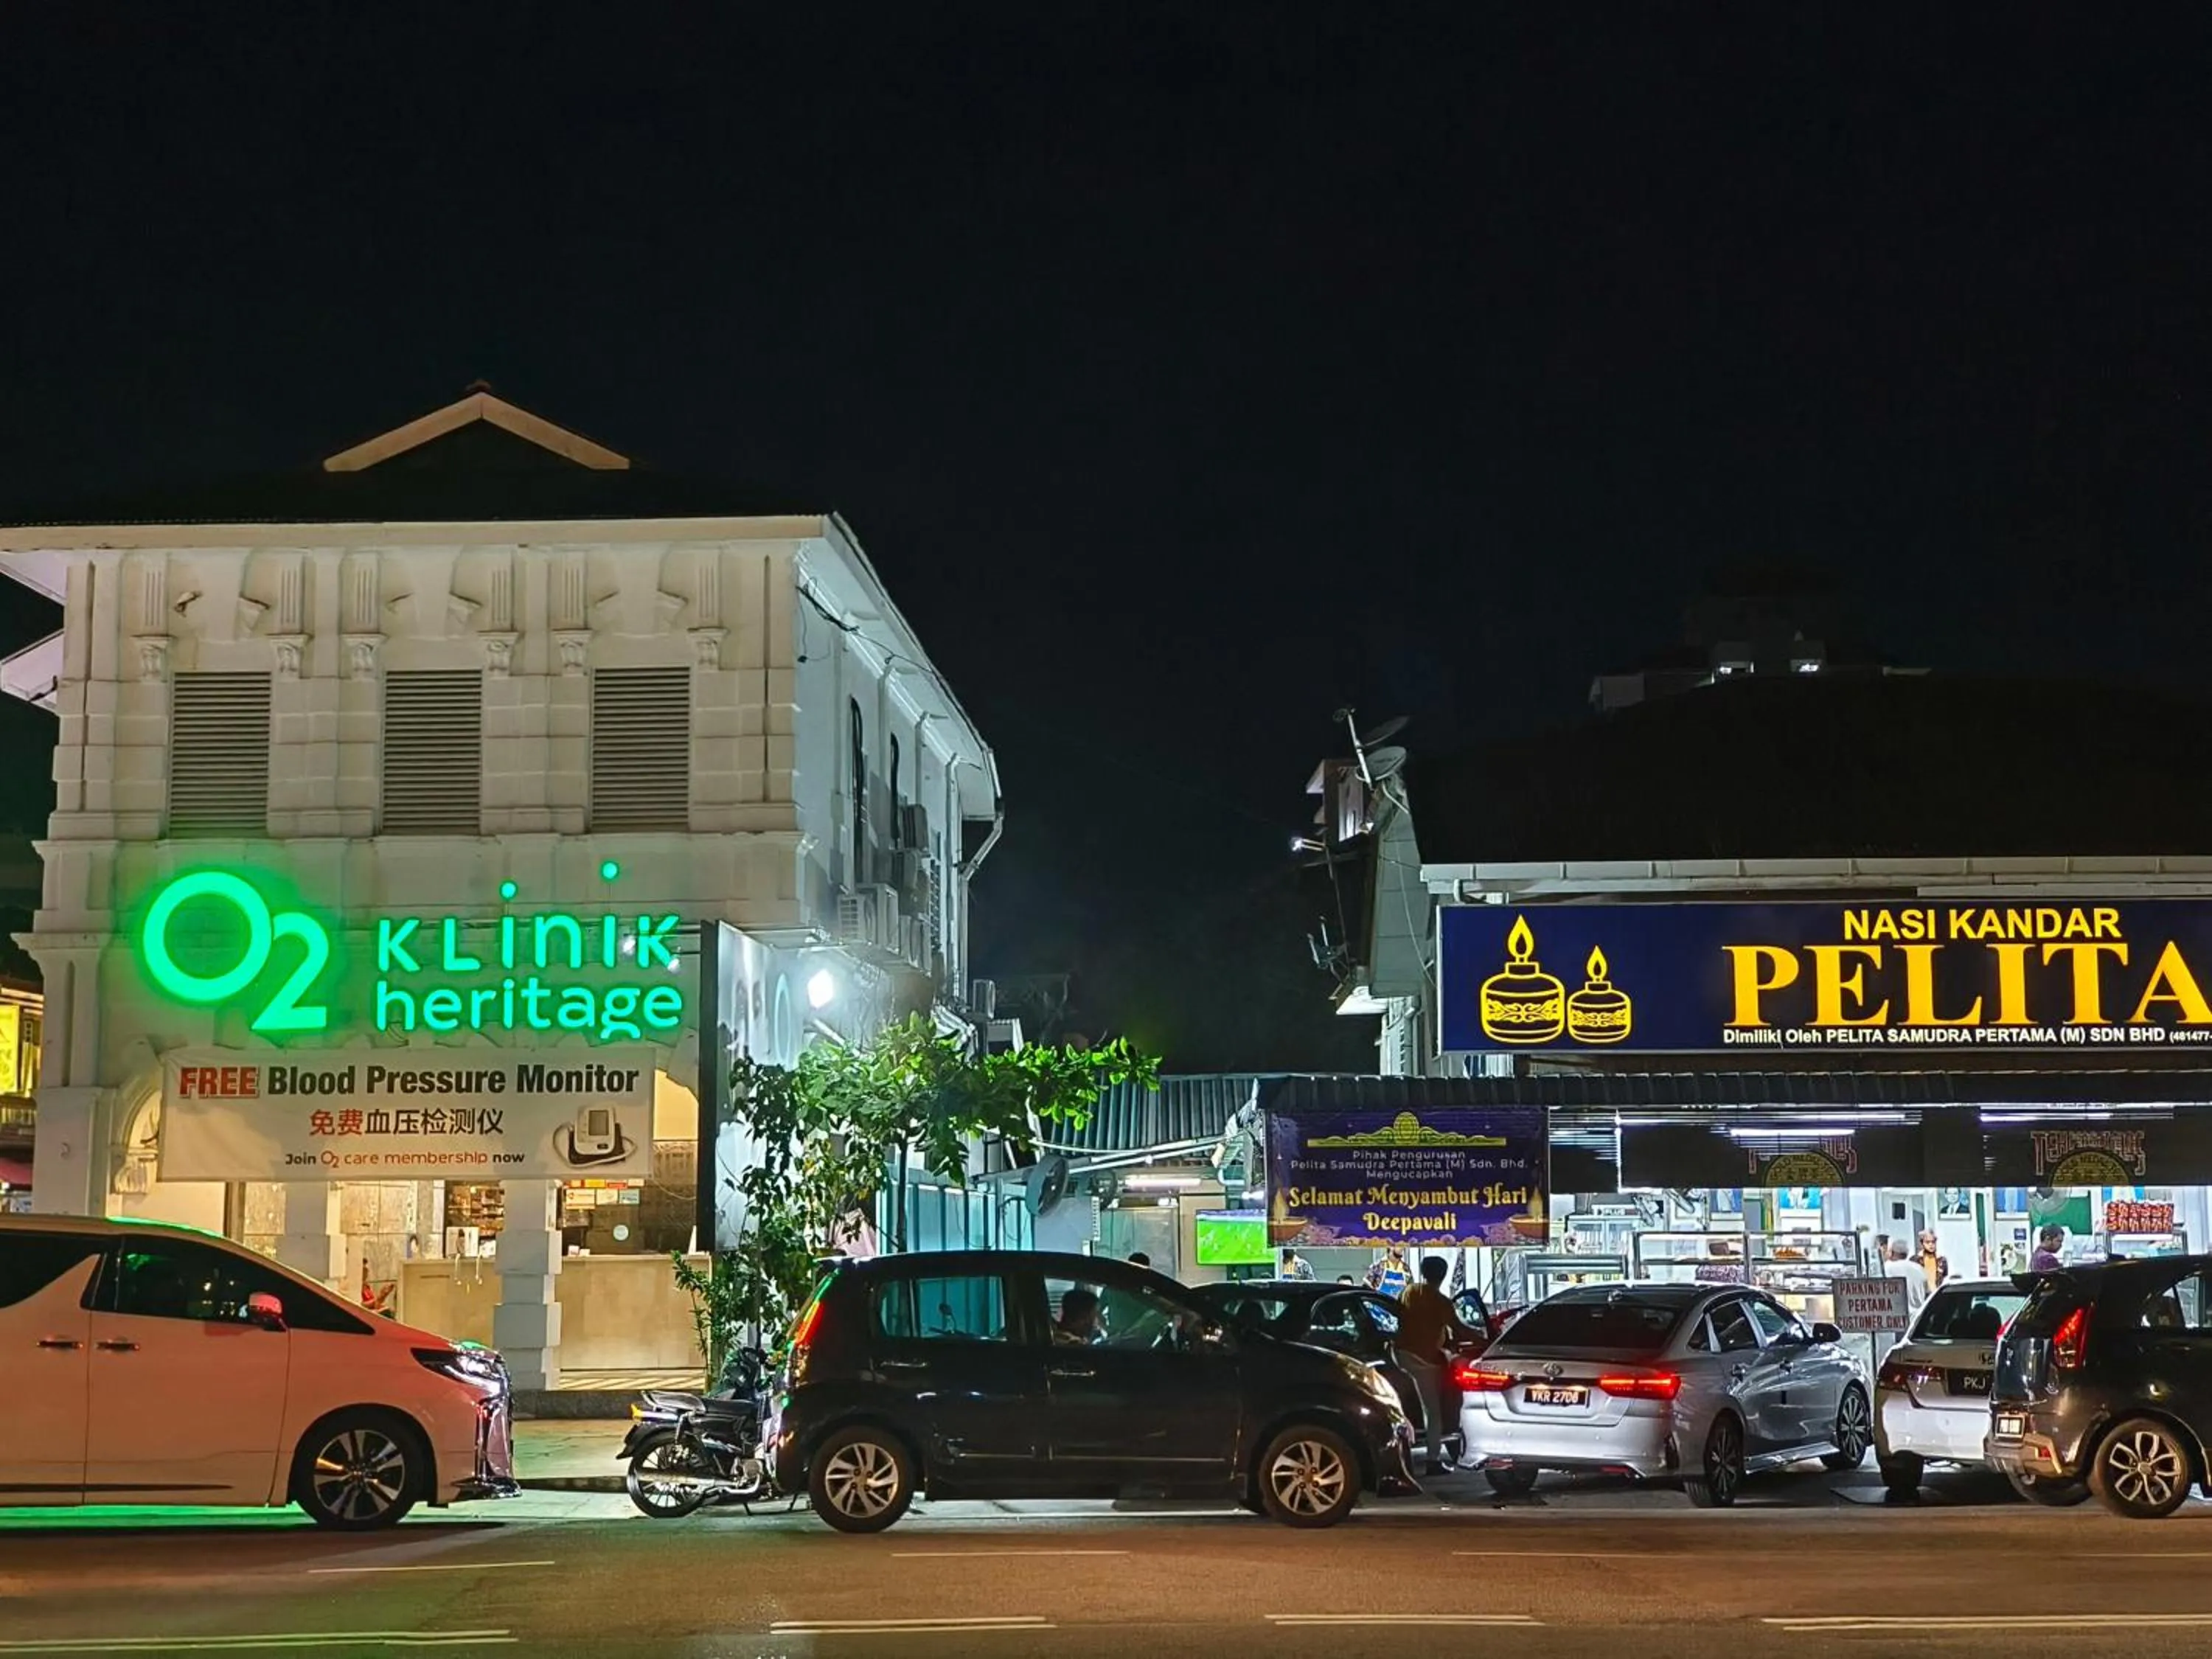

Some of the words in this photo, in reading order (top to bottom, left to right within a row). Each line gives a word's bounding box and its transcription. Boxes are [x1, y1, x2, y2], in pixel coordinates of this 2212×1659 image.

[1844, 909, 1936, 940] NASI
[1950, 908, 2122, 939] KANDAR
[1722, 940, 2212, 1026] PELITA
[377, 978, 683, 1039] heritage
[1723, 1029, 1782, 1043] Dimiliki
[1785, 1029, 1822, 1043] Oleh
[1826, 1029, 1884, 1043] PELITA
[1887, 1029, 1972, 1043] SAMUDRA
[1975, 1028, 2057, 1043] PERTAMA
[2061, 1026, 2086, 1044] (M)
[2090, 1027, 2125, 1042] SDN
[2129, 1027, 2166, 1042] BHD
[179, 1067, 260, 1098] FREE
[267, 1065, 357, 1096] Blood
[366, 1065, 507, 1094] Pressure
[516, 1063, 640, 1093] Monitor
[309, 1107, 504, 1136] 免费血压检测仪
[285, 1152, 317, 1166] Join
[344, 1155, 380, 1166] care
[384, 1151, 489, 1166] membership
[492, 1152, 526, 1164] now
[1290, 1160, 1326, 1169] Pelita
[1330, 1160, 1385, 1169] Samudra
[1389, 1160, 1441, 1169] Pertama
[1470, 1158, 1496, 1169] Sdn.
[1500, 1158, 1528, 1169] Bhd.
[1353, 1150, 1387, 1158] Pihak
[1391, 1150, 1466, 1161] Pengurusan
[1366, 1169, 1453, 1181] Mengucapkan
[1289, 1186, 1363, 1208] Selamat
[1368, 1183, 1478, 1210] Menyambut
[1483, 1181, 1527, 1208] Hari
[1363, 1211, 1457, 1235] Deepavali
[1848, 1298, 1893, 1312] PERTAMA
[1964, 1377, 1986, 1389] PKJ
